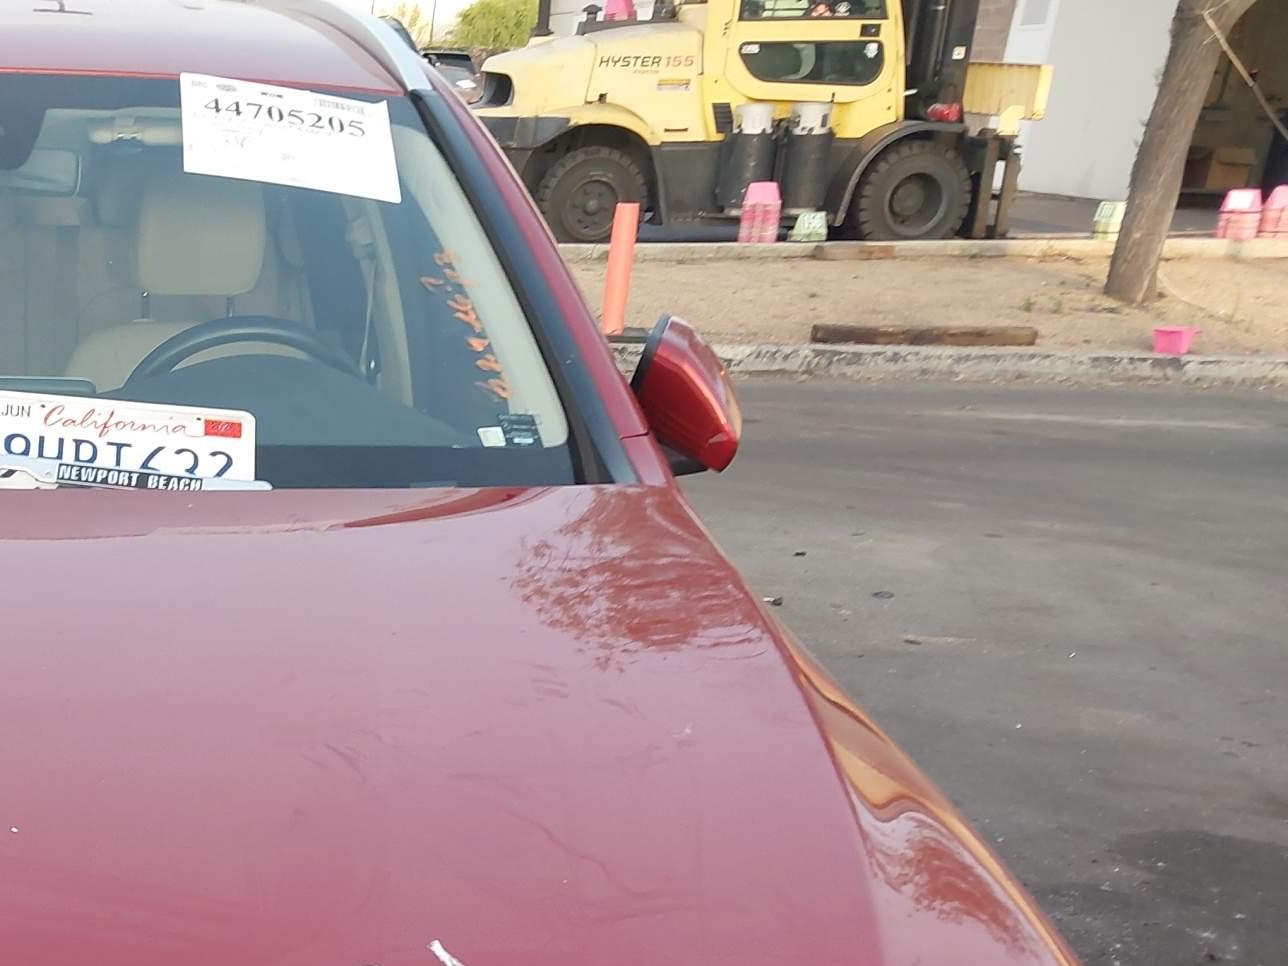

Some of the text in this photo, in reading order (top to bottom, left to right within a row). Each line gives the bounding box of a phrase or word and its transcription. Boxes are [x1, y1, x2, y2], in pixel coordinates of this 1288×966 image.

[598, 55, 695, 68] HYSTER 155
[204, 96, 366, 138] 44705205
[0, 403, 32, 417] JUN
[43, 404, 198, 437] California
[58, 464, 203, 490] NEWPORT BEACH
